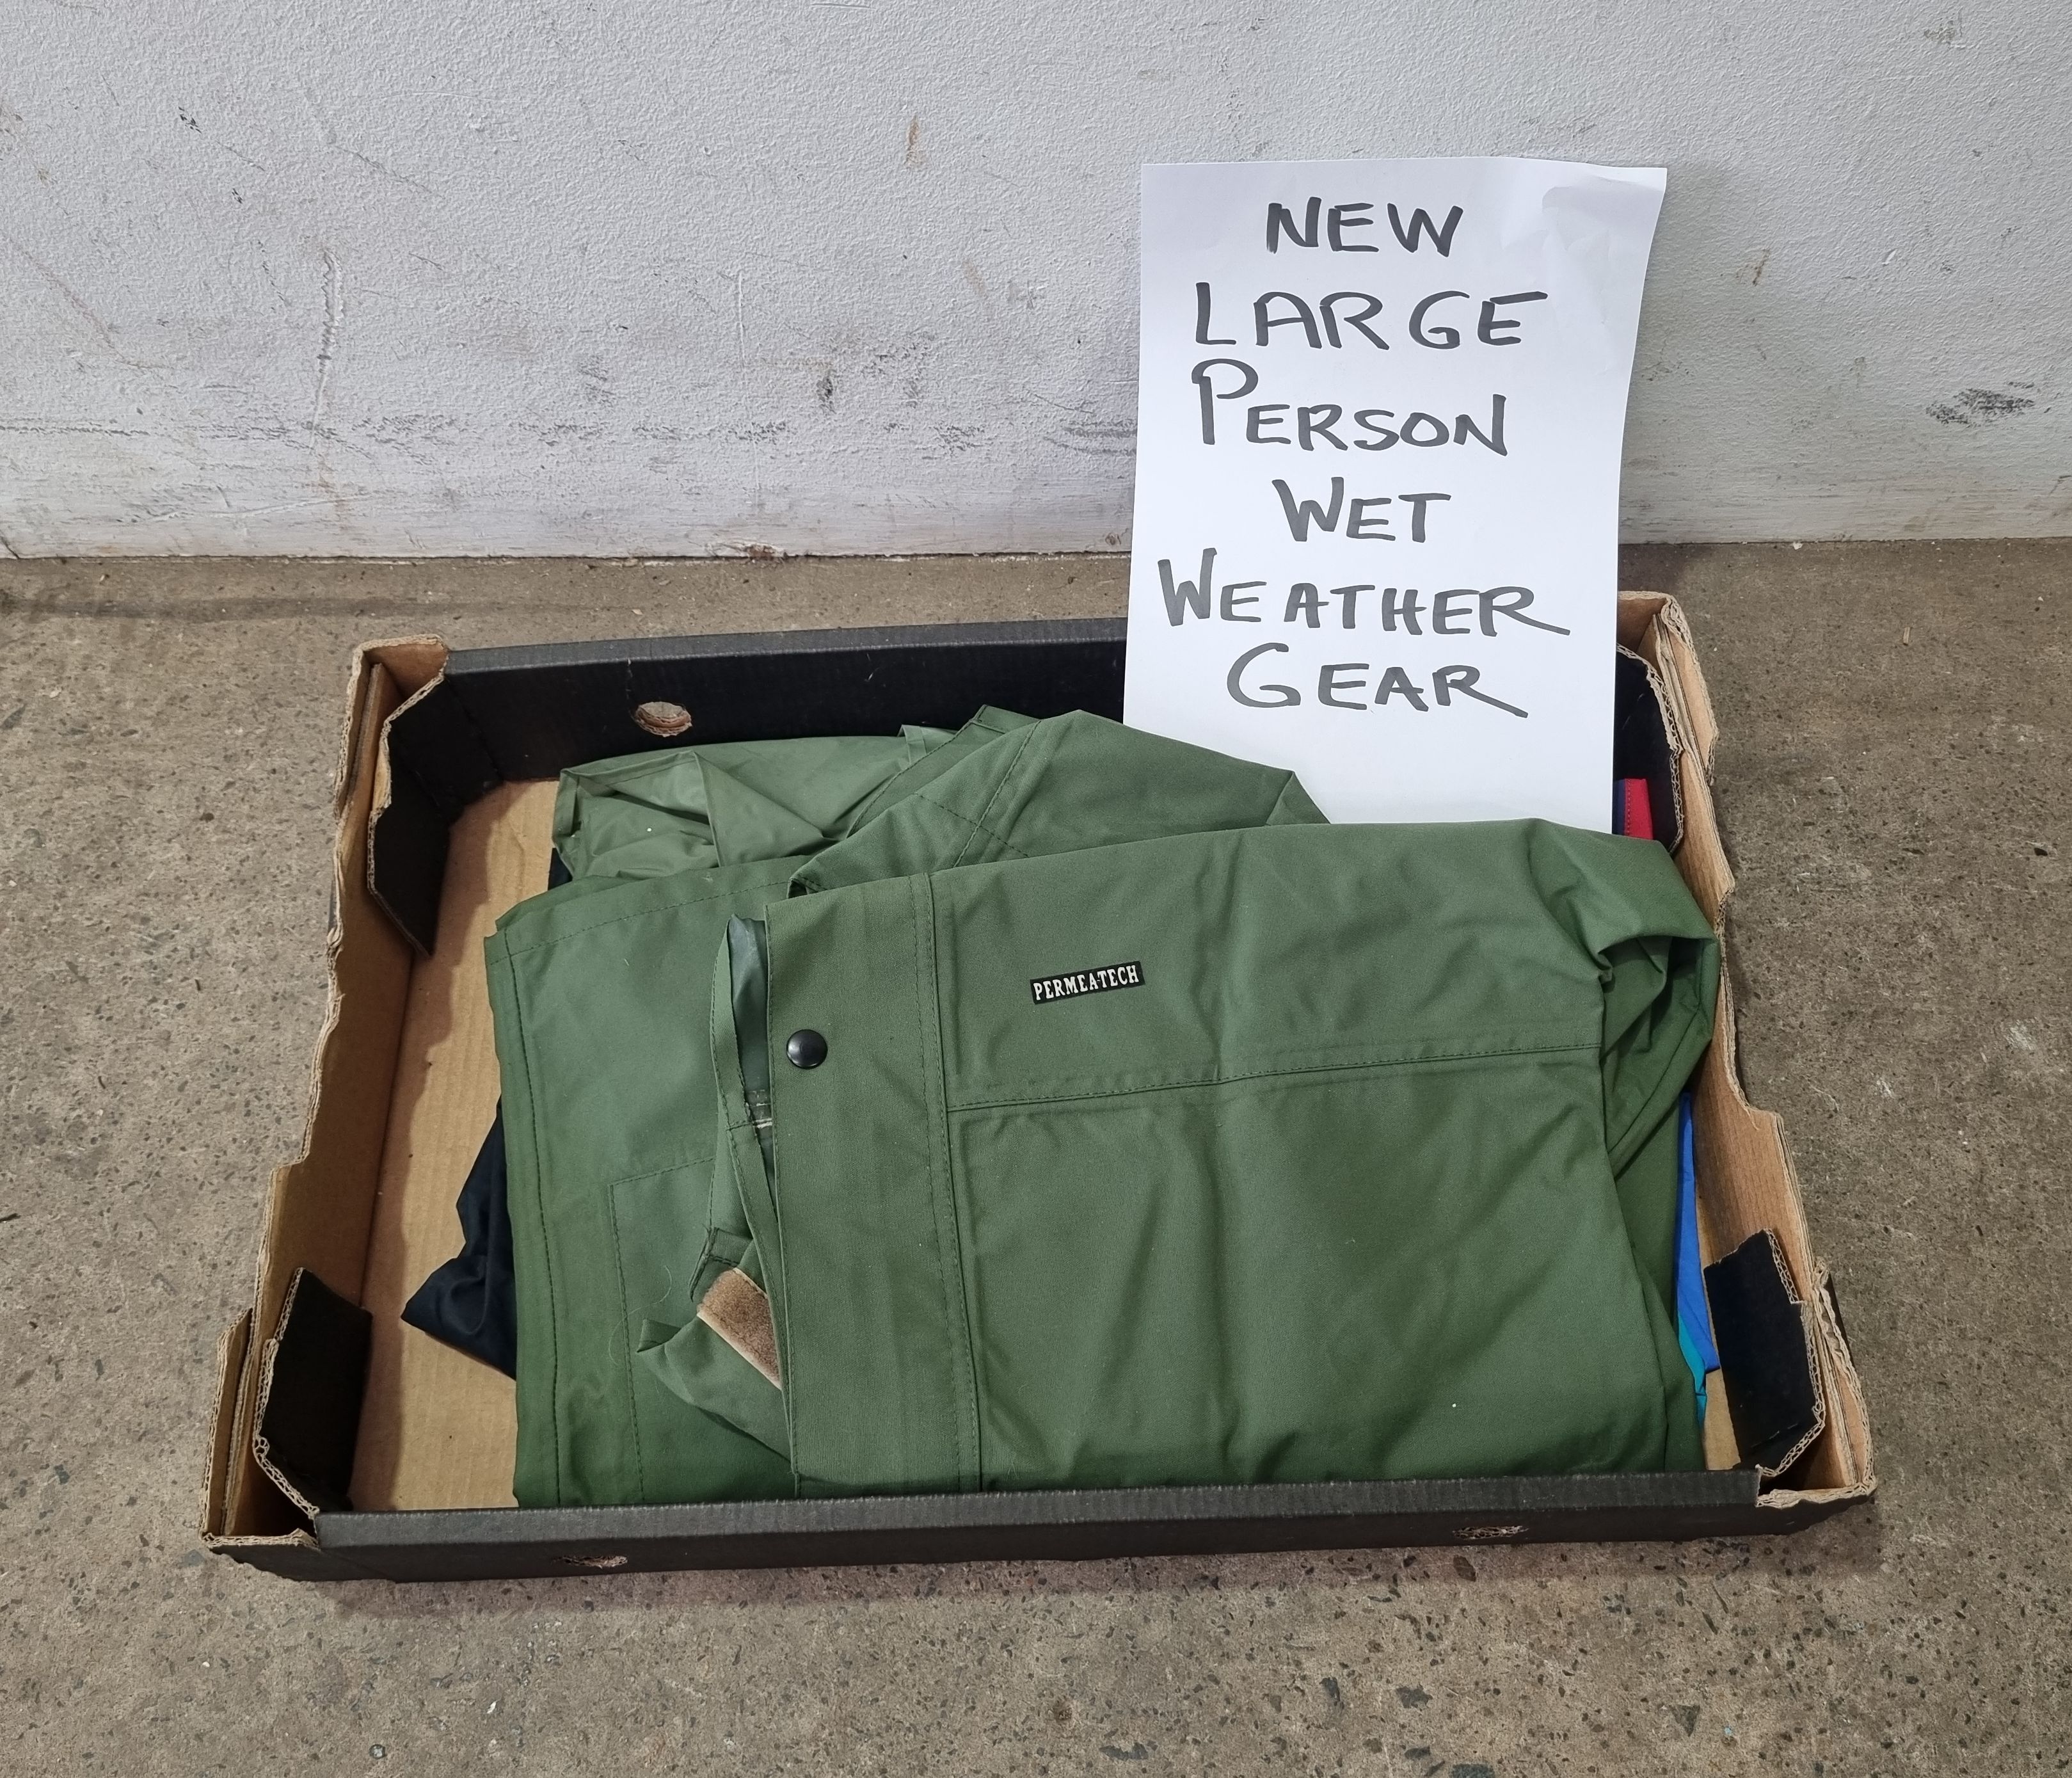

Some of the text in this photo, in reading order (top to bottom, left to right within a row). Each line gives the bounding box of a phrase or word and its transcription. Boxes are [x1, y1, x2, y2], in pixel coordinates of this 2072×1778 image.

[1266, 196, 1463, 257] NEW
[1196, 282, 1548, 350] LARGE
[1191, 358, 1507, 456] PERSON
[1272, 477, 1451, 543] WET
[1158, 547, 1570, 637] WEATHER
[1227, 643, 1528, 718] GEAR
